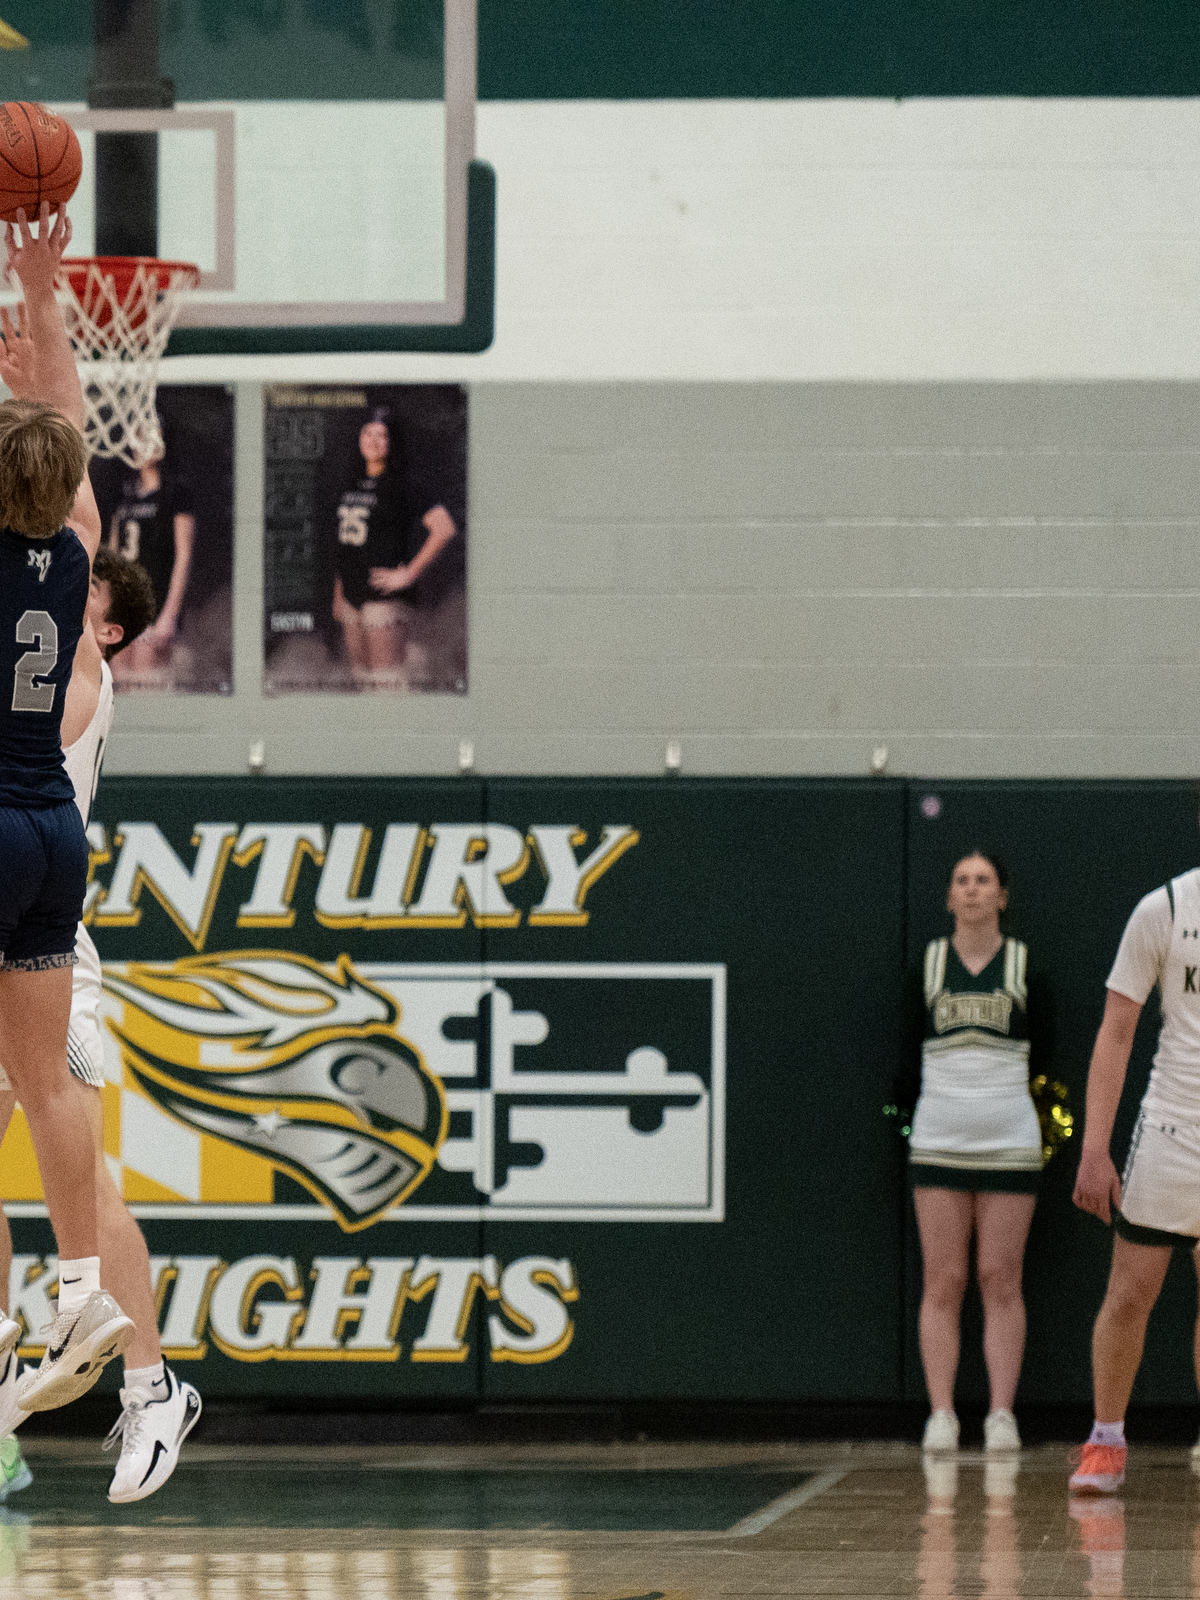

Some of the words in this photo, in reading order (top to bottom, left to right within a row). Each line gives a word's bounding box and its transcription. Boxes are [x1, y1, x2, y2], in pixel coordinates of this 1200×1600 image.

[11, 609, 59, 713] 2
[81, 820, 640, 951] NTURY
[7, 1253, 580, 1364] KIGHTS
